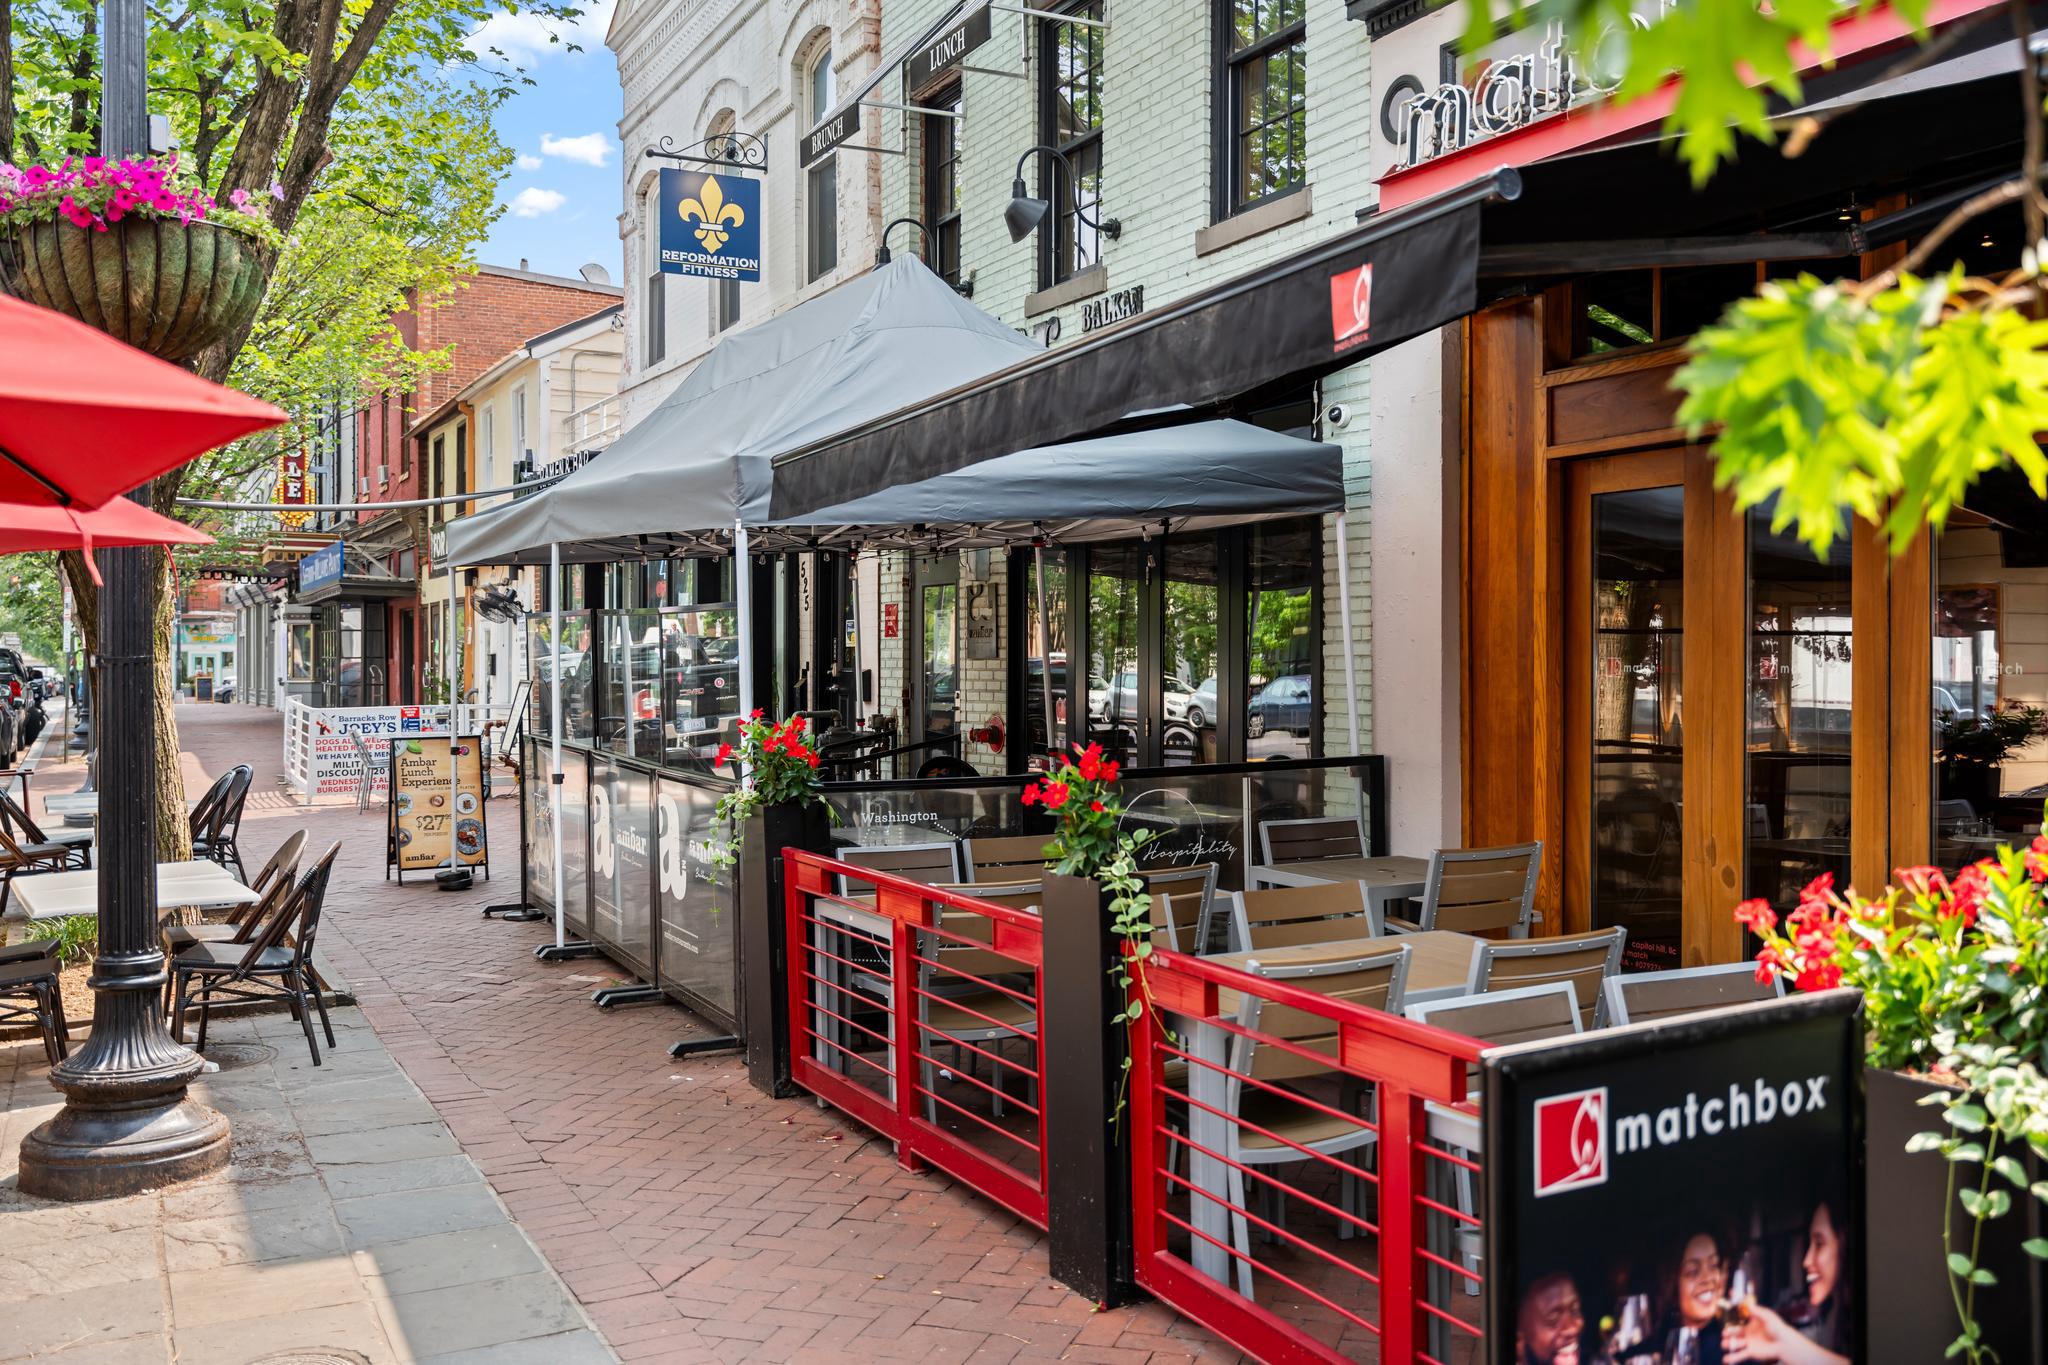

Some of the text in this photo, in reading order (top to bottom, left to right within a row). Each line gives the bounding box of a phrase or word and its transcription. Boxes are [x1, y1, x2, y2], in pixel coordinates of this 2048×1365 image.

[929, 27, 966, 72] LUNCH
[811, 115, 844, 155] BRUNCH
[661, 249, 759, 269] REFORMATION
[682, 264, 739, 278] FITNESS
[1081, 284, 1144, 332] BALKAN
[801, 561, 809, 611] 525
[339, 714, 396, 723] Barracks Row
[315, 738, 340, 746] DOGS
[341, 736, 383, 745] ALWED
[315, 745, 350, 753] HEATED
[316, 753, 329, 761] WE
[401, 757, 437, 767] Ambar
[401, 766, 434, 777] Lunch
[320, 777, 377, 786] WEDNESDS
[316, 785, 354, 794] BURGERS
[860, 810, 938, 824] Washington
[1142, 840, 1238, 865] Hospitality
[1615, 1075, 1828, 1155] matchbox
